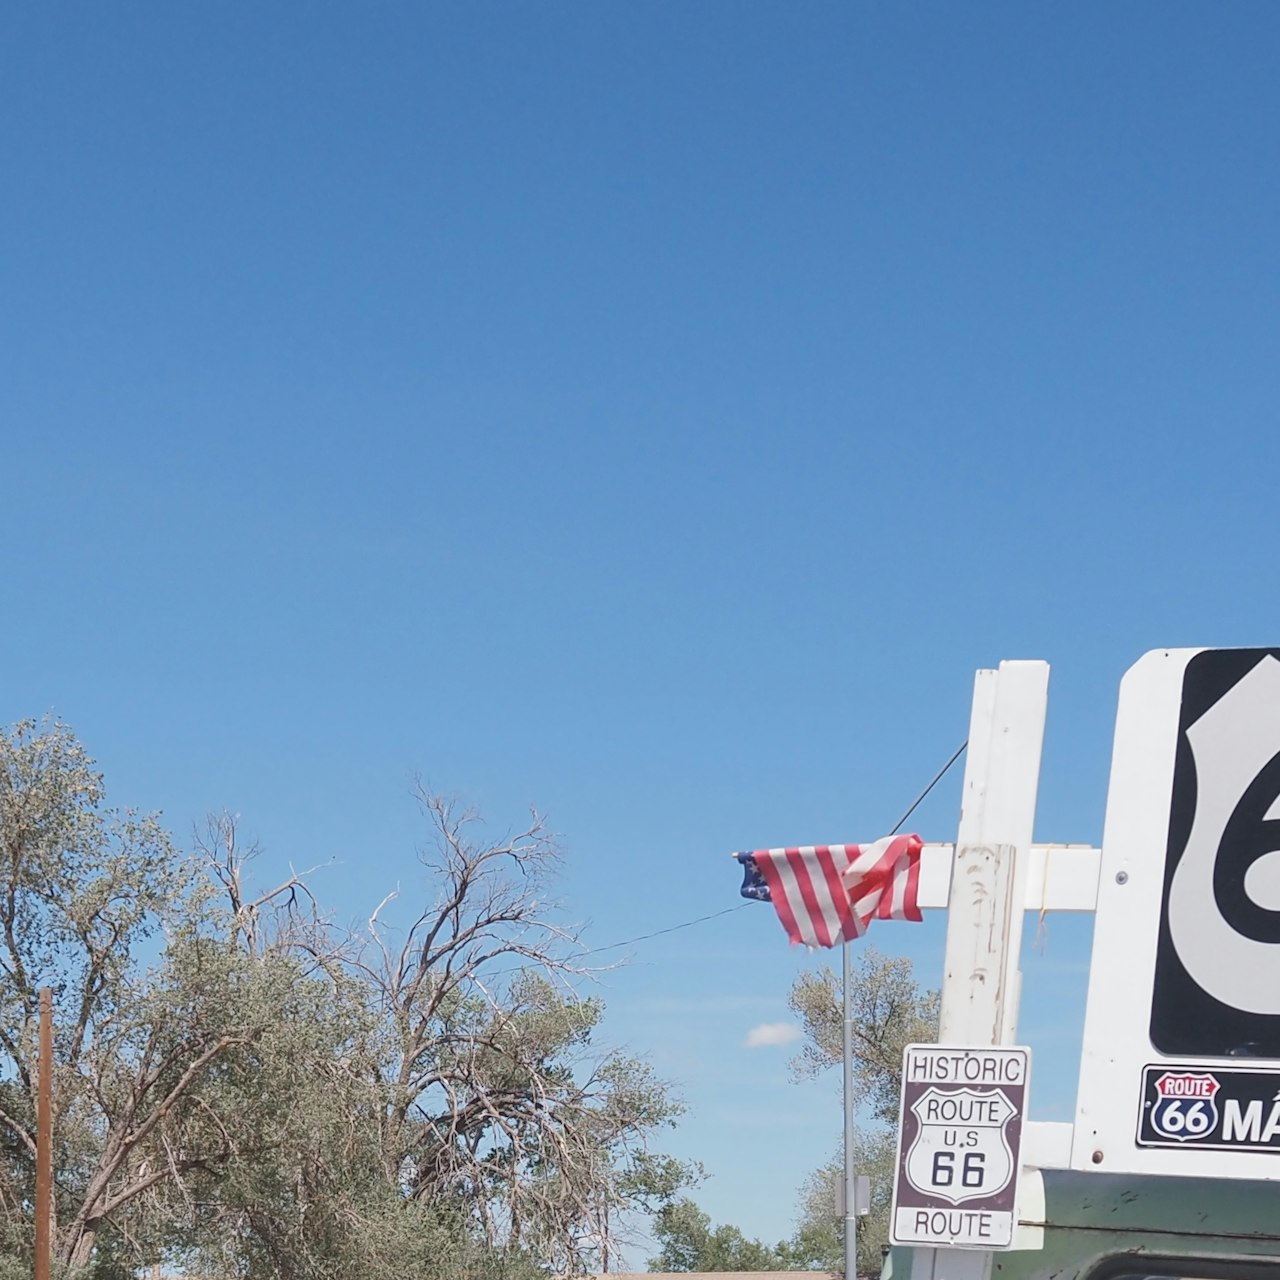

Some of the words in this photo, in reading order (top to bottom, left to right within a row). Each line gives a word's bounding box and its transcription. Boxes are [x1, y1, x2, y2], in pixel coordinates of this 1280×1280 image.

[913, 1056, 1020, 1082] HISTORIC
[1164, 1079, 1211, 1097] ROUTE
[927, 1099, 999, 1122] ROUTE
[1160, 1100, 1209, 1133] 66
[932, 1151, 985, 1187] 66
[915, 1210, 992, 1237] ROUTE
